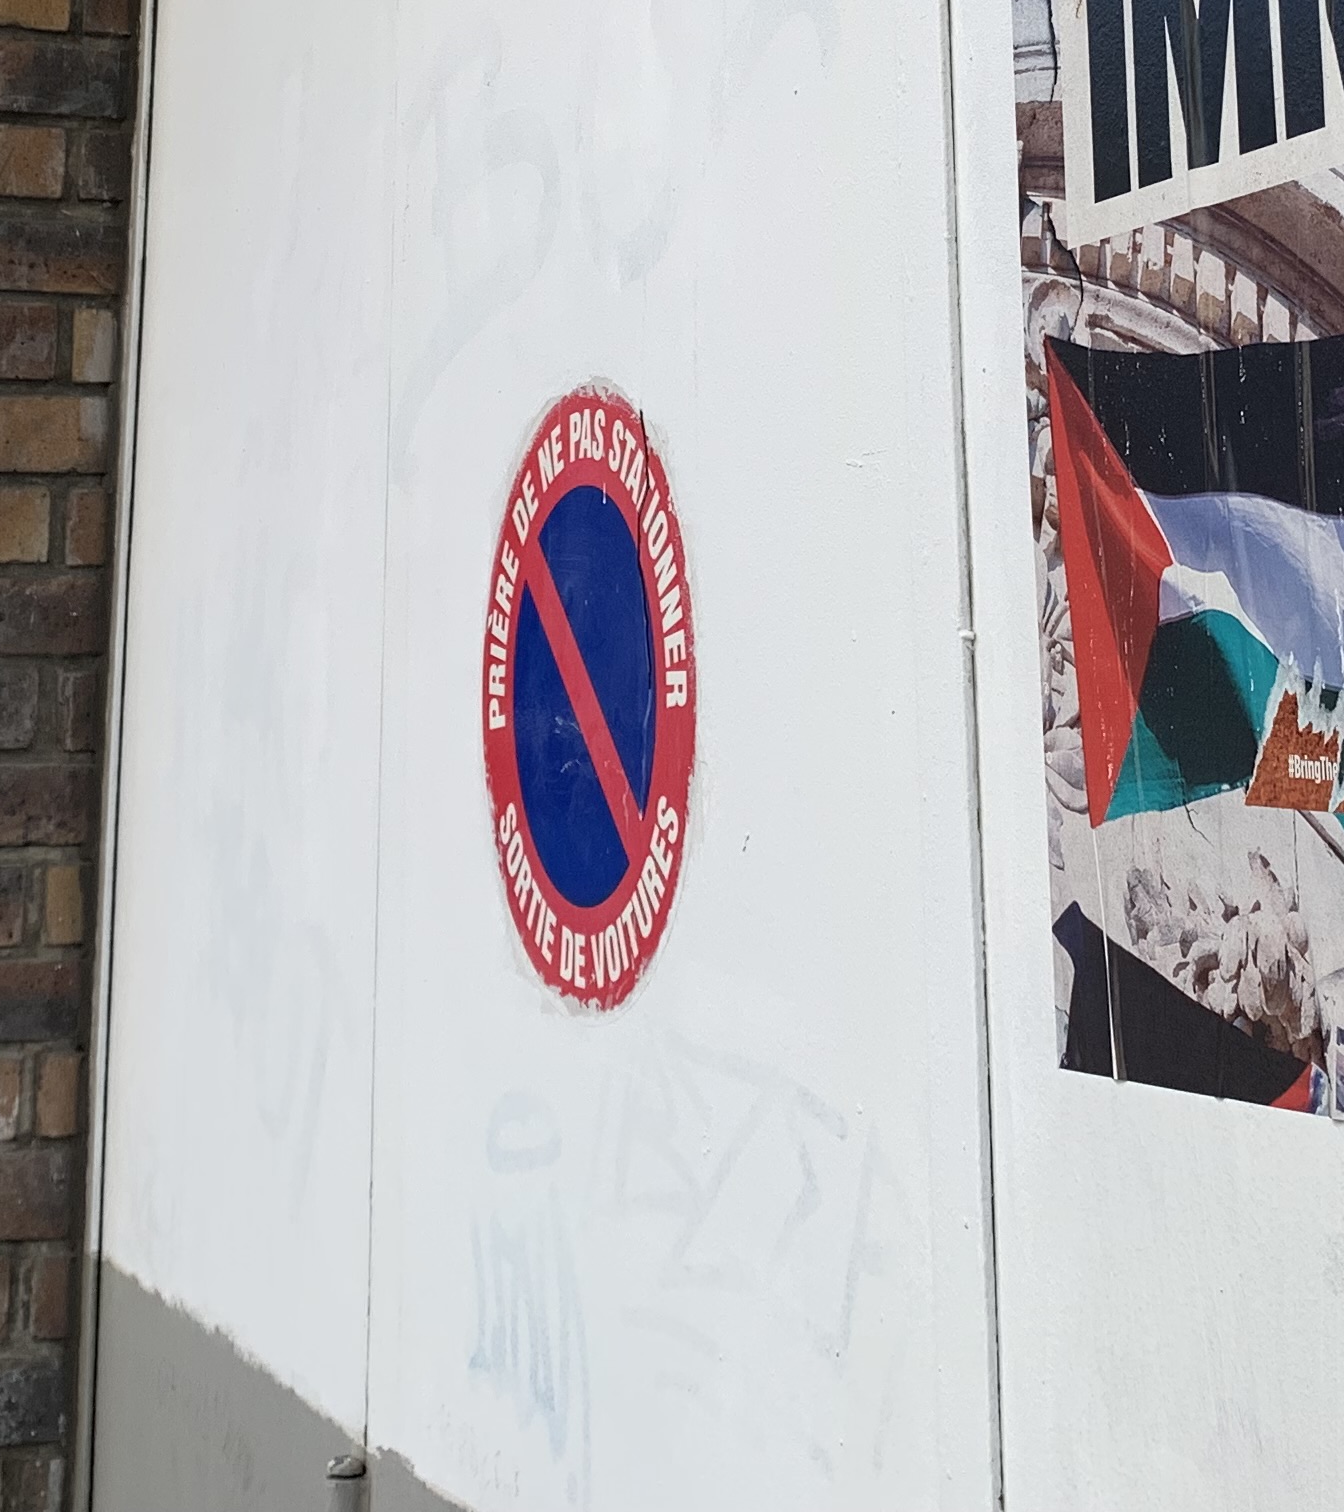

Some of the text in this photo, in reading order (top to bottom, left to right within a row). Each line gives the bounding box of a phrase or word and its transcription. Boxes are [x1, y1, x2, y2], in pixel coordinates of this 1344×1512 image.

[488, 408, 688, 730] PRIÈRE DE NE PAS STATIONNER
[499, 795, 679, 989] SORTIE DE VOITURES
